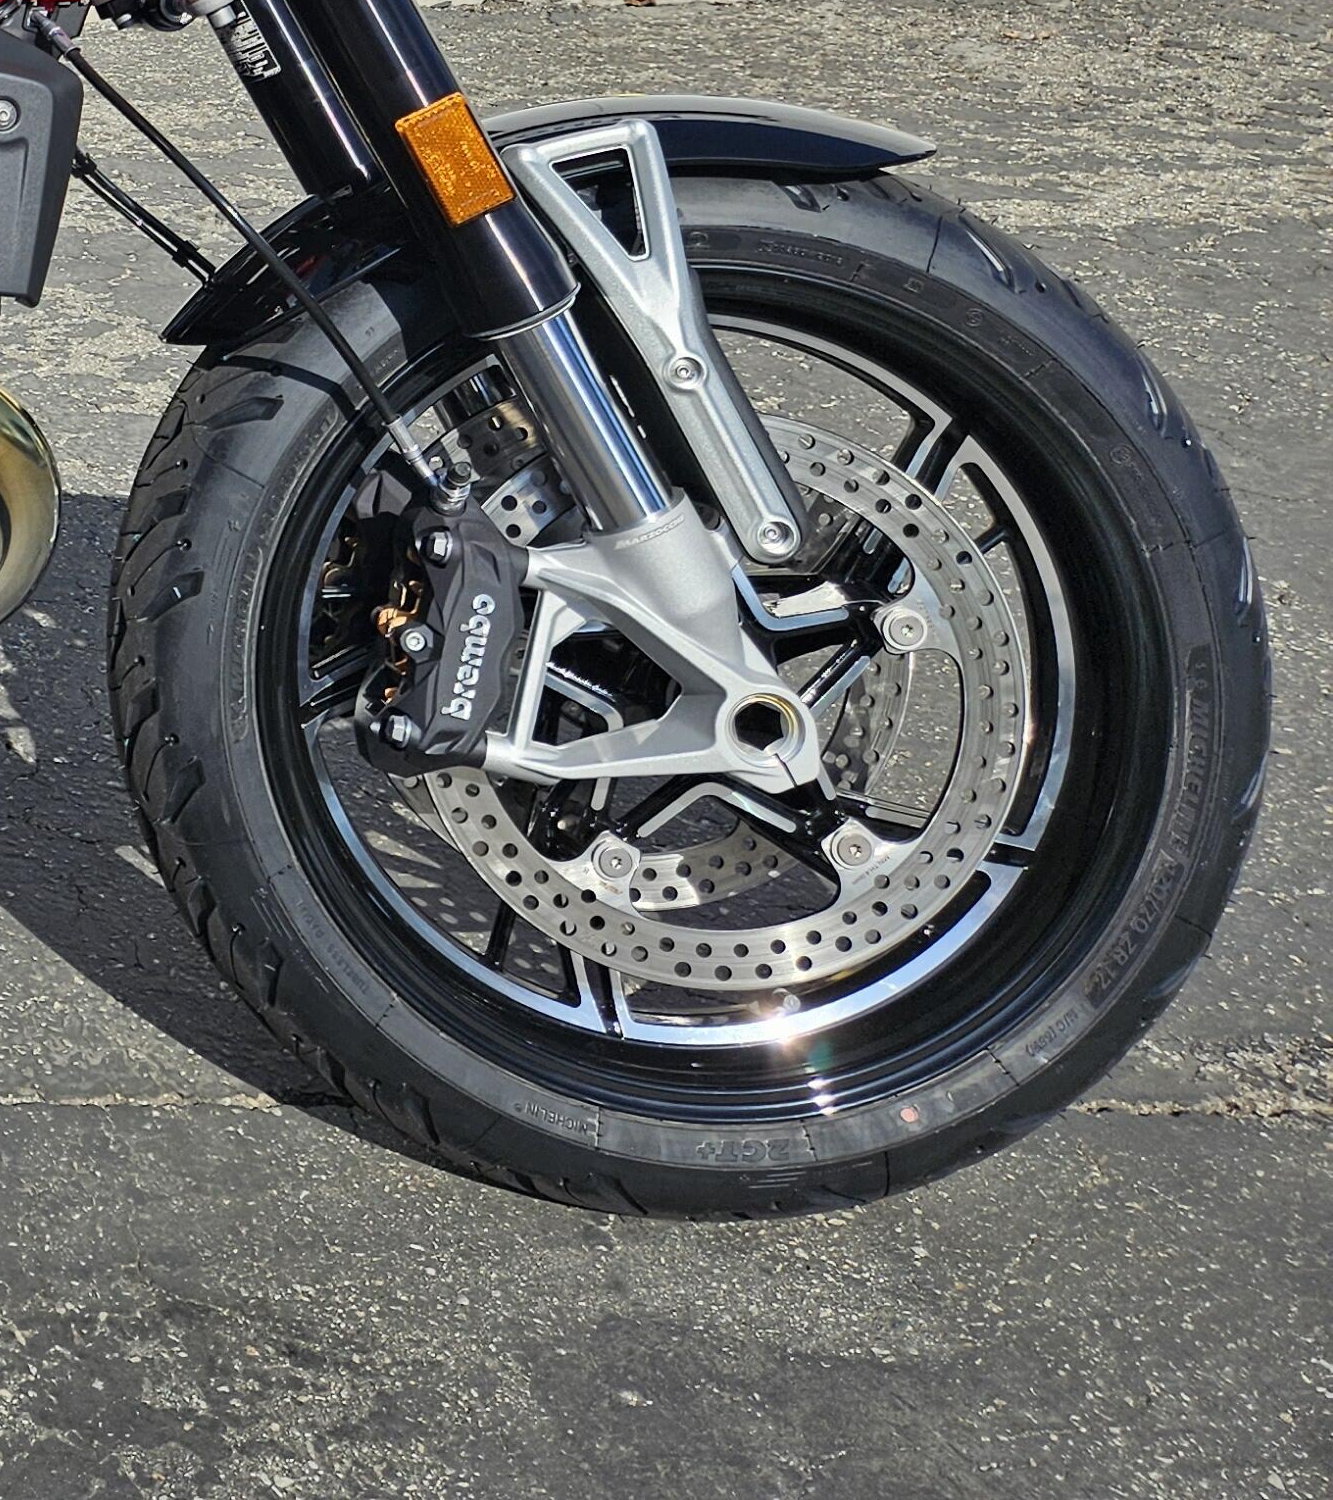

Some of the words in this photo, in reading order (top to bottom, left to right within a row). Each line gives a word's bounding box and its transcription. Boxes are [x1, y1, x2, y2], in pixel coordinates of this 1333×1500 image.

[441, 593, 496, 721] brembo
[524, 1101, 592, 1136] MICHELIN
[696, 1137, 791, 1163] 2CT+
